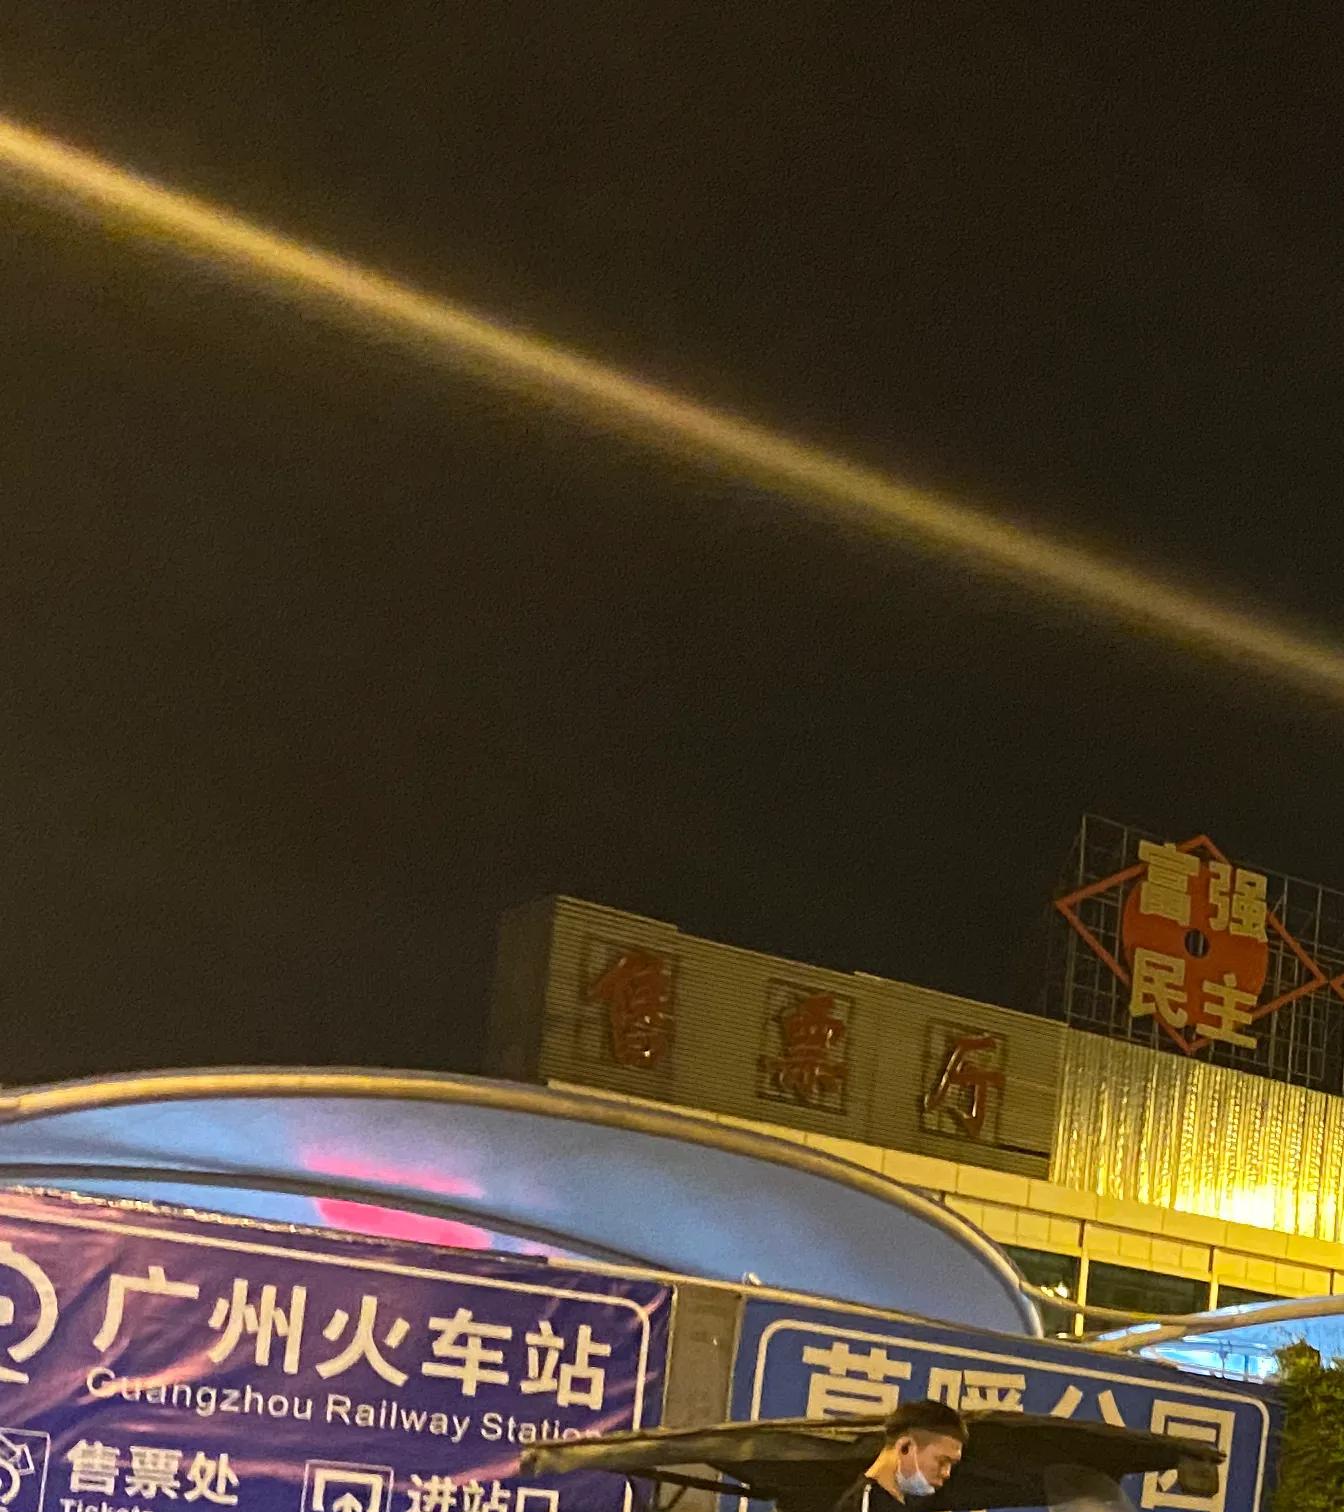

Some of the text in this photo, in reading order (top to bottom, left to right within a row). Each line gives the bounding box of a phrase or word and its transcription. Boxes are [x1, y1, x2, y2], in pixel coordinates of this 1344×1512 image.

[1138, 840, 1268, 943] 富强
[1129, 948, 1258, 1049] 民主
[93, 1266, 612, 1411] 广州火车站
[86, 1366, 312, 1422] Guangzhou
[326, 1396, 470, 1442] Railway
[66, 1439, 239, 1506] 售票处
